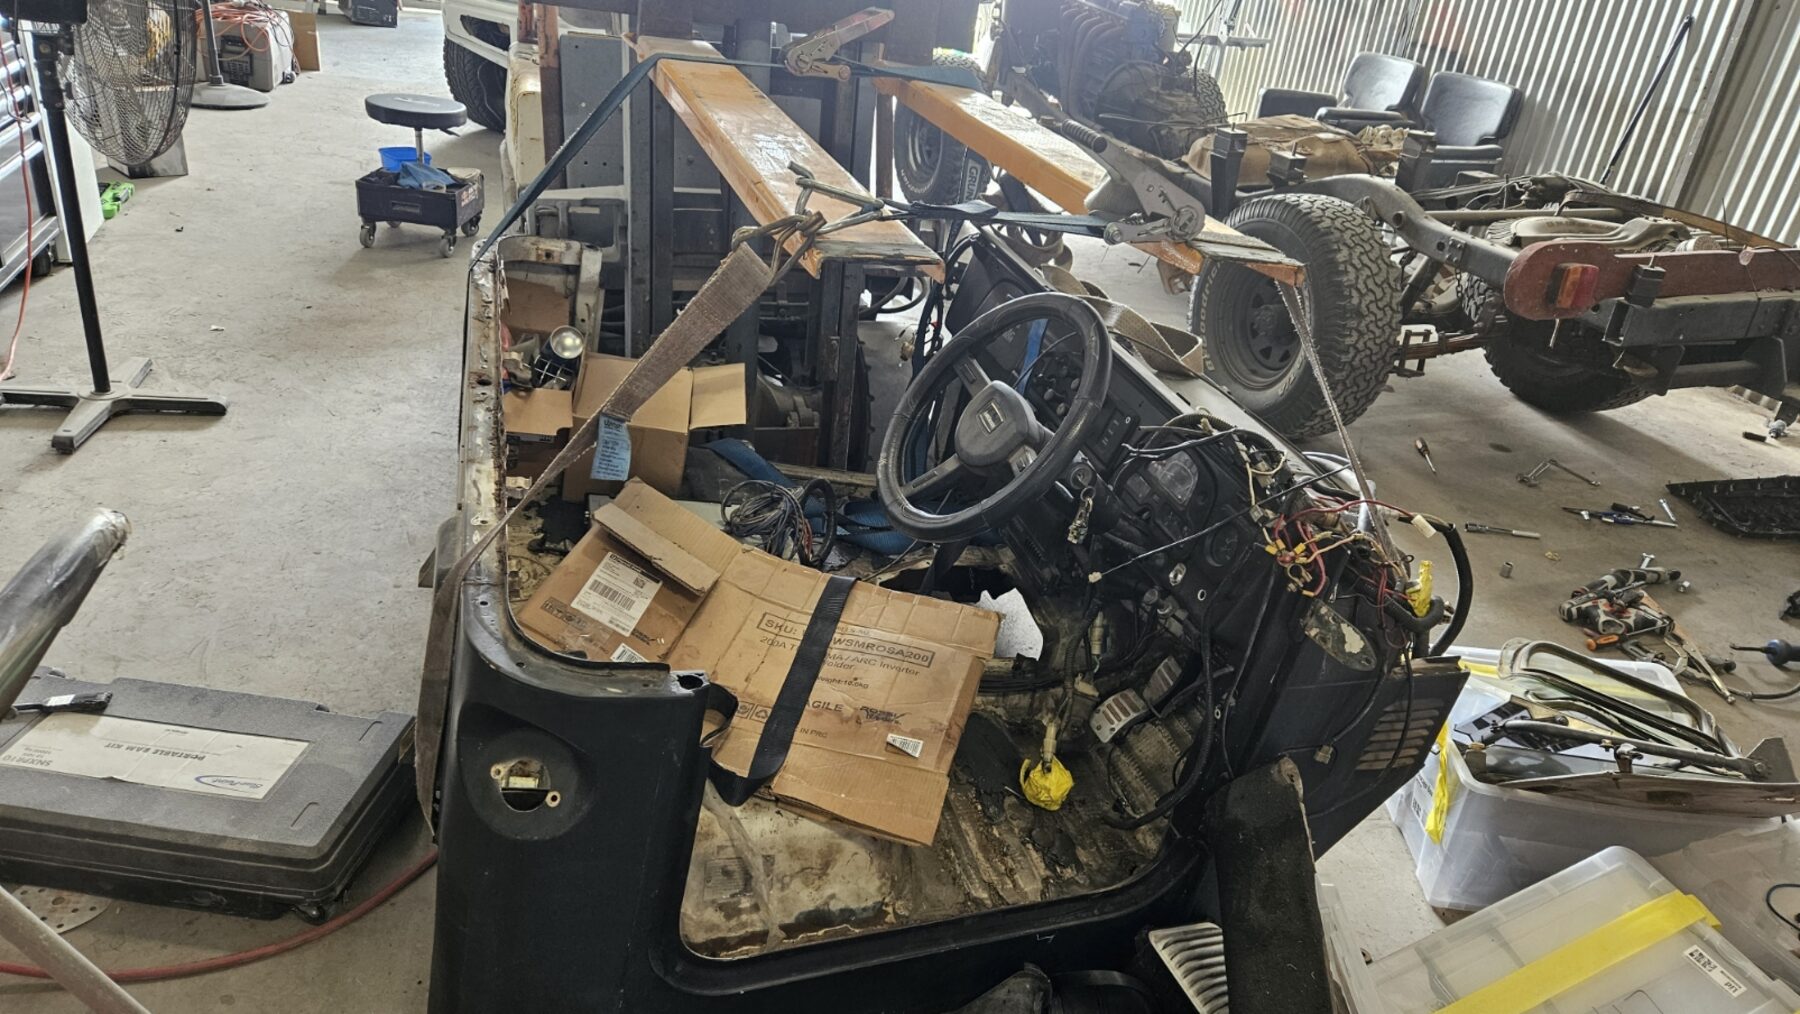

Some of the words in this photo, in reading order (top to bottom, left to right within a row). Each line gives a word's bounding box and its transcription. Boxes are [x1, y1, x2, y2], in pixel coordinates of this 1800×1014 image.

[764, 619, 797, 635] SKU:
[760, 636, 787, 650] 200A
[852, 656, 877, 666] ARC
